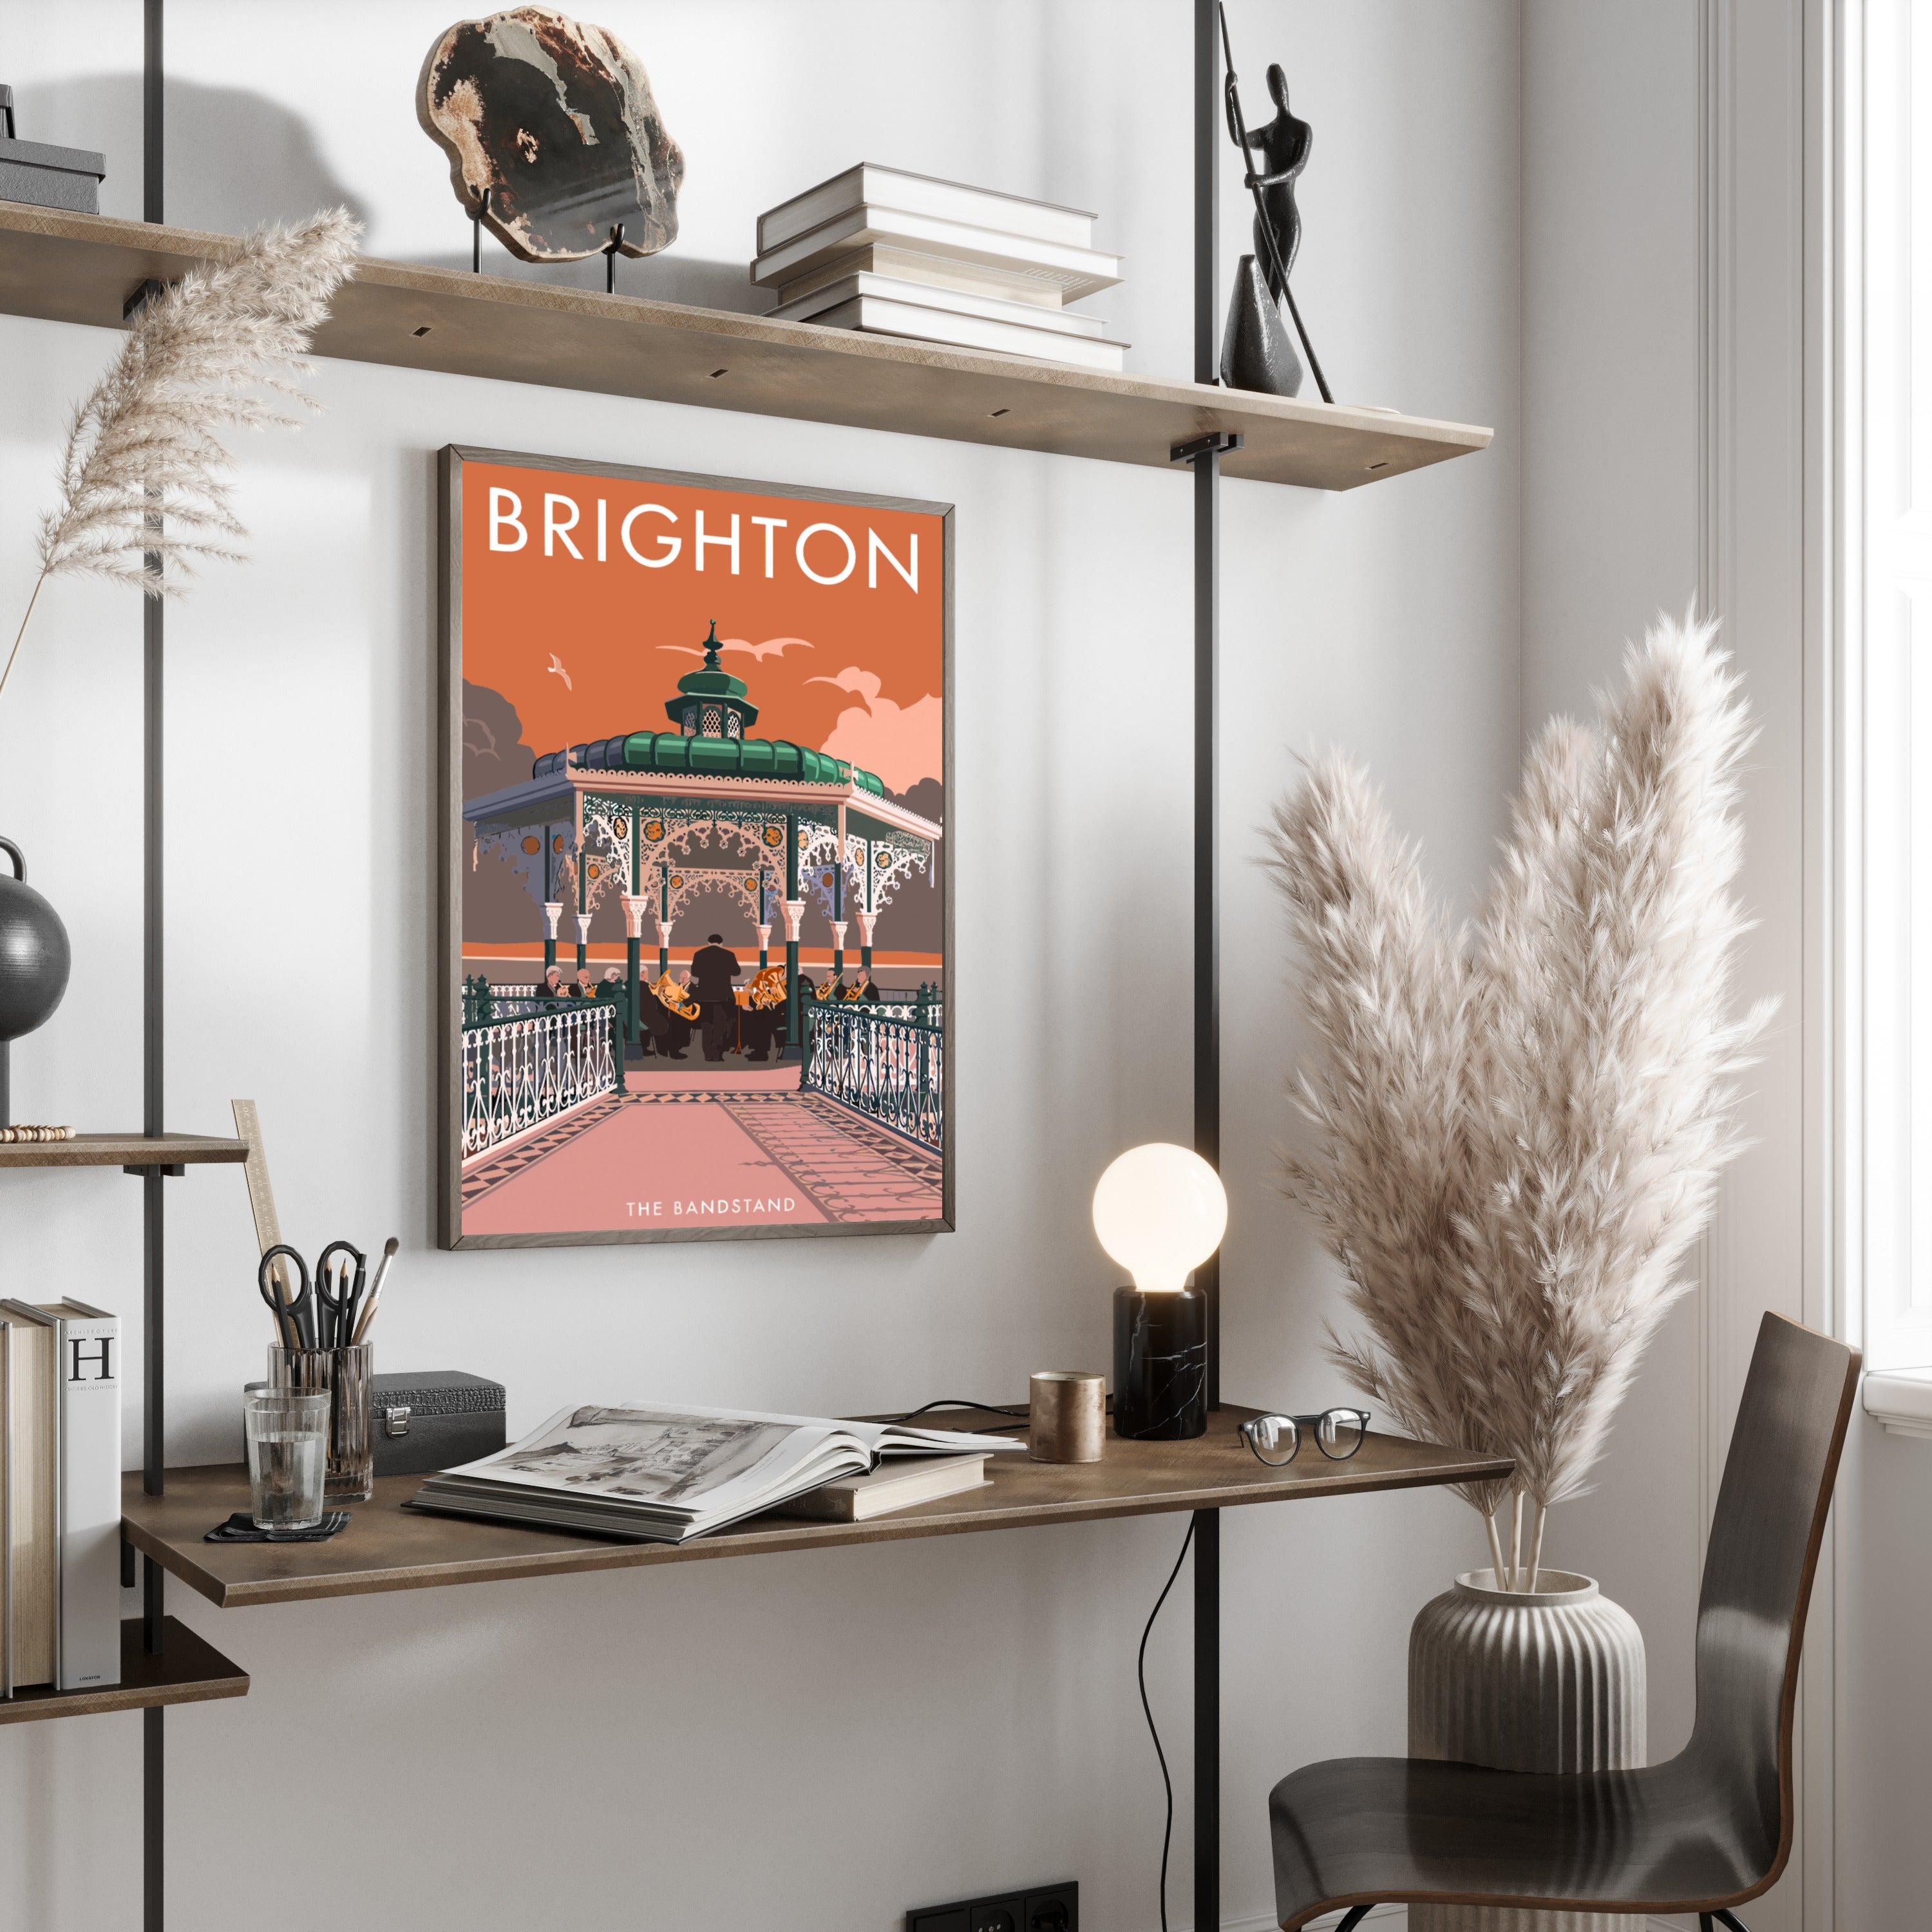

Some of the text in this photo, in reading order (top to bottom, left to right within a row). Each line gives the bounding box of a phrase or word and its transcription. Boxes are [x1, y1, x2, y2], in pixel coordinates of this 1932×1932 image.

[488, 486, 919, 594] BRIGHTON
[626, 1198, 795, 1217] THE BANDSTAND
[68, 1337, 115, 1381] H
